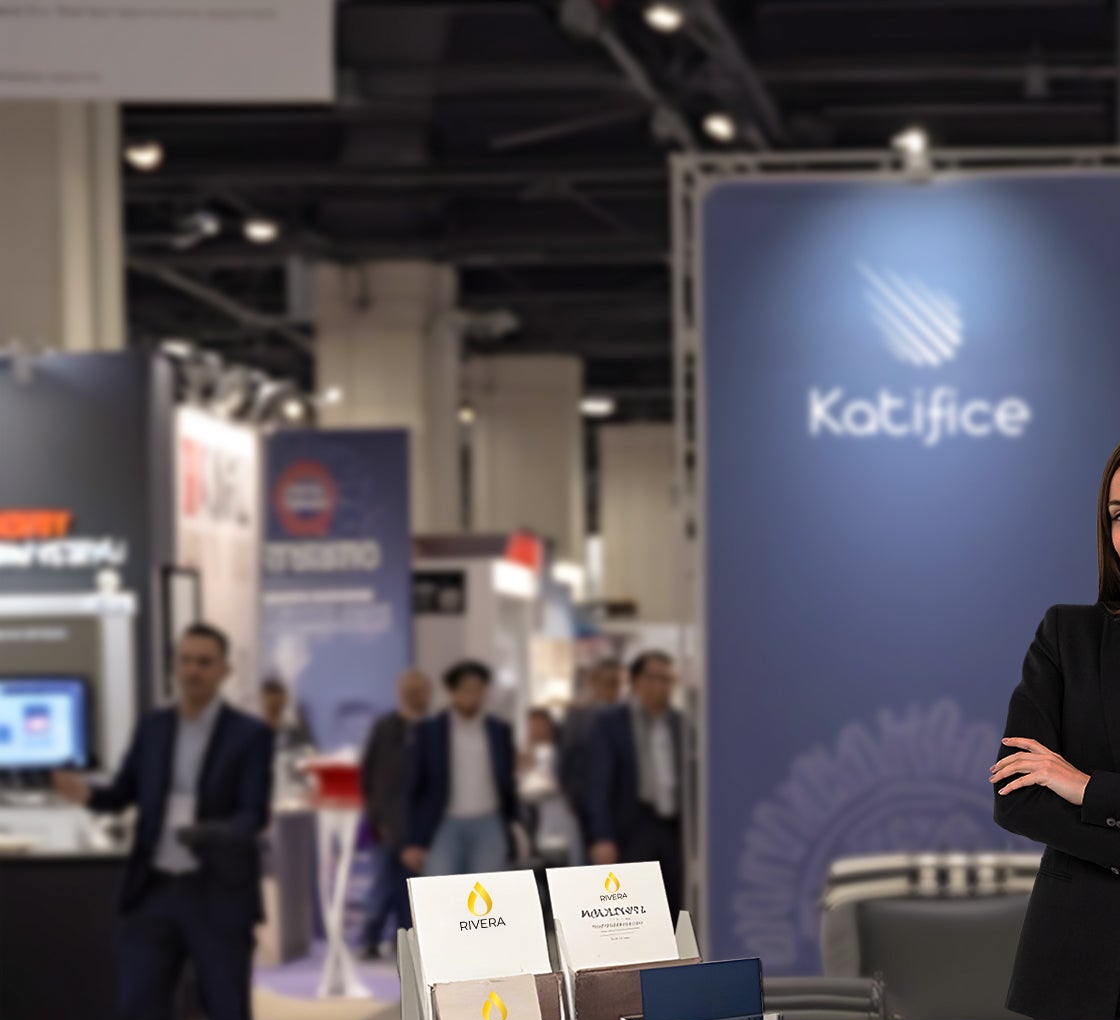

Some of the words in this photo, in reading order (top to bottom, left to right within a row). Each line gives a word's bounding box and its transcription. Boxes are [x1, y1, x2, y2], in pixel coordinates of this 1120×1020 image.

[807, 384, 1032, 447] Katifice
[598, 892, 629, 903] RIVERA
[458, 916, 507, 932] RIVERA
